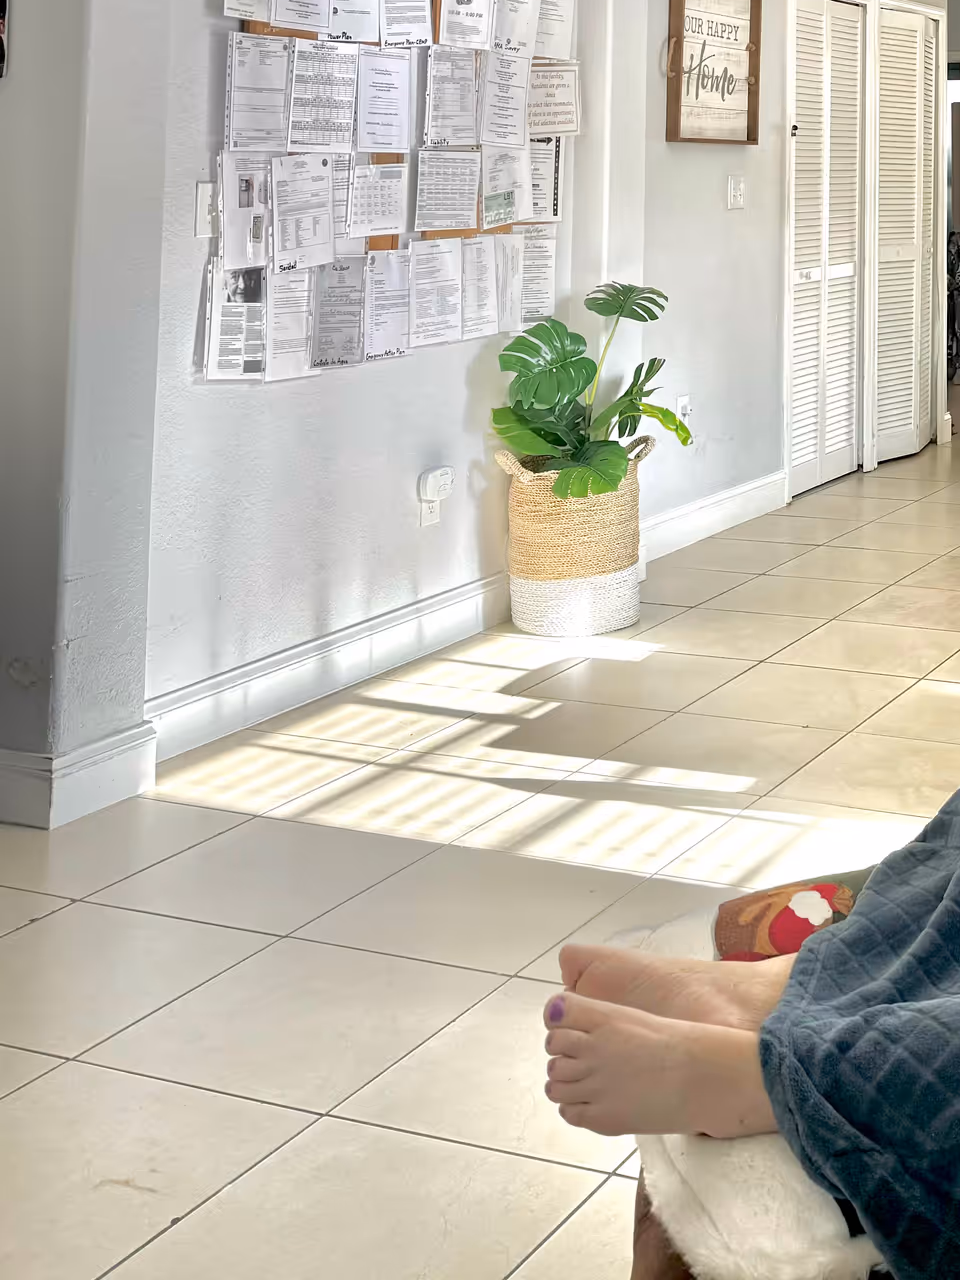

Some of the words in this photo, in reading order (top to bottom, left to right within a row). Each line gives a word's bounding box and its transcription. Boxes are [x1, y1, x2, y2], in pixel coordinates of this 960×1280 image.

[684, 15, 704, 36] OUR
[706, 20, 740, 42] HAPPY
[683, 39, 738, 102] Home
